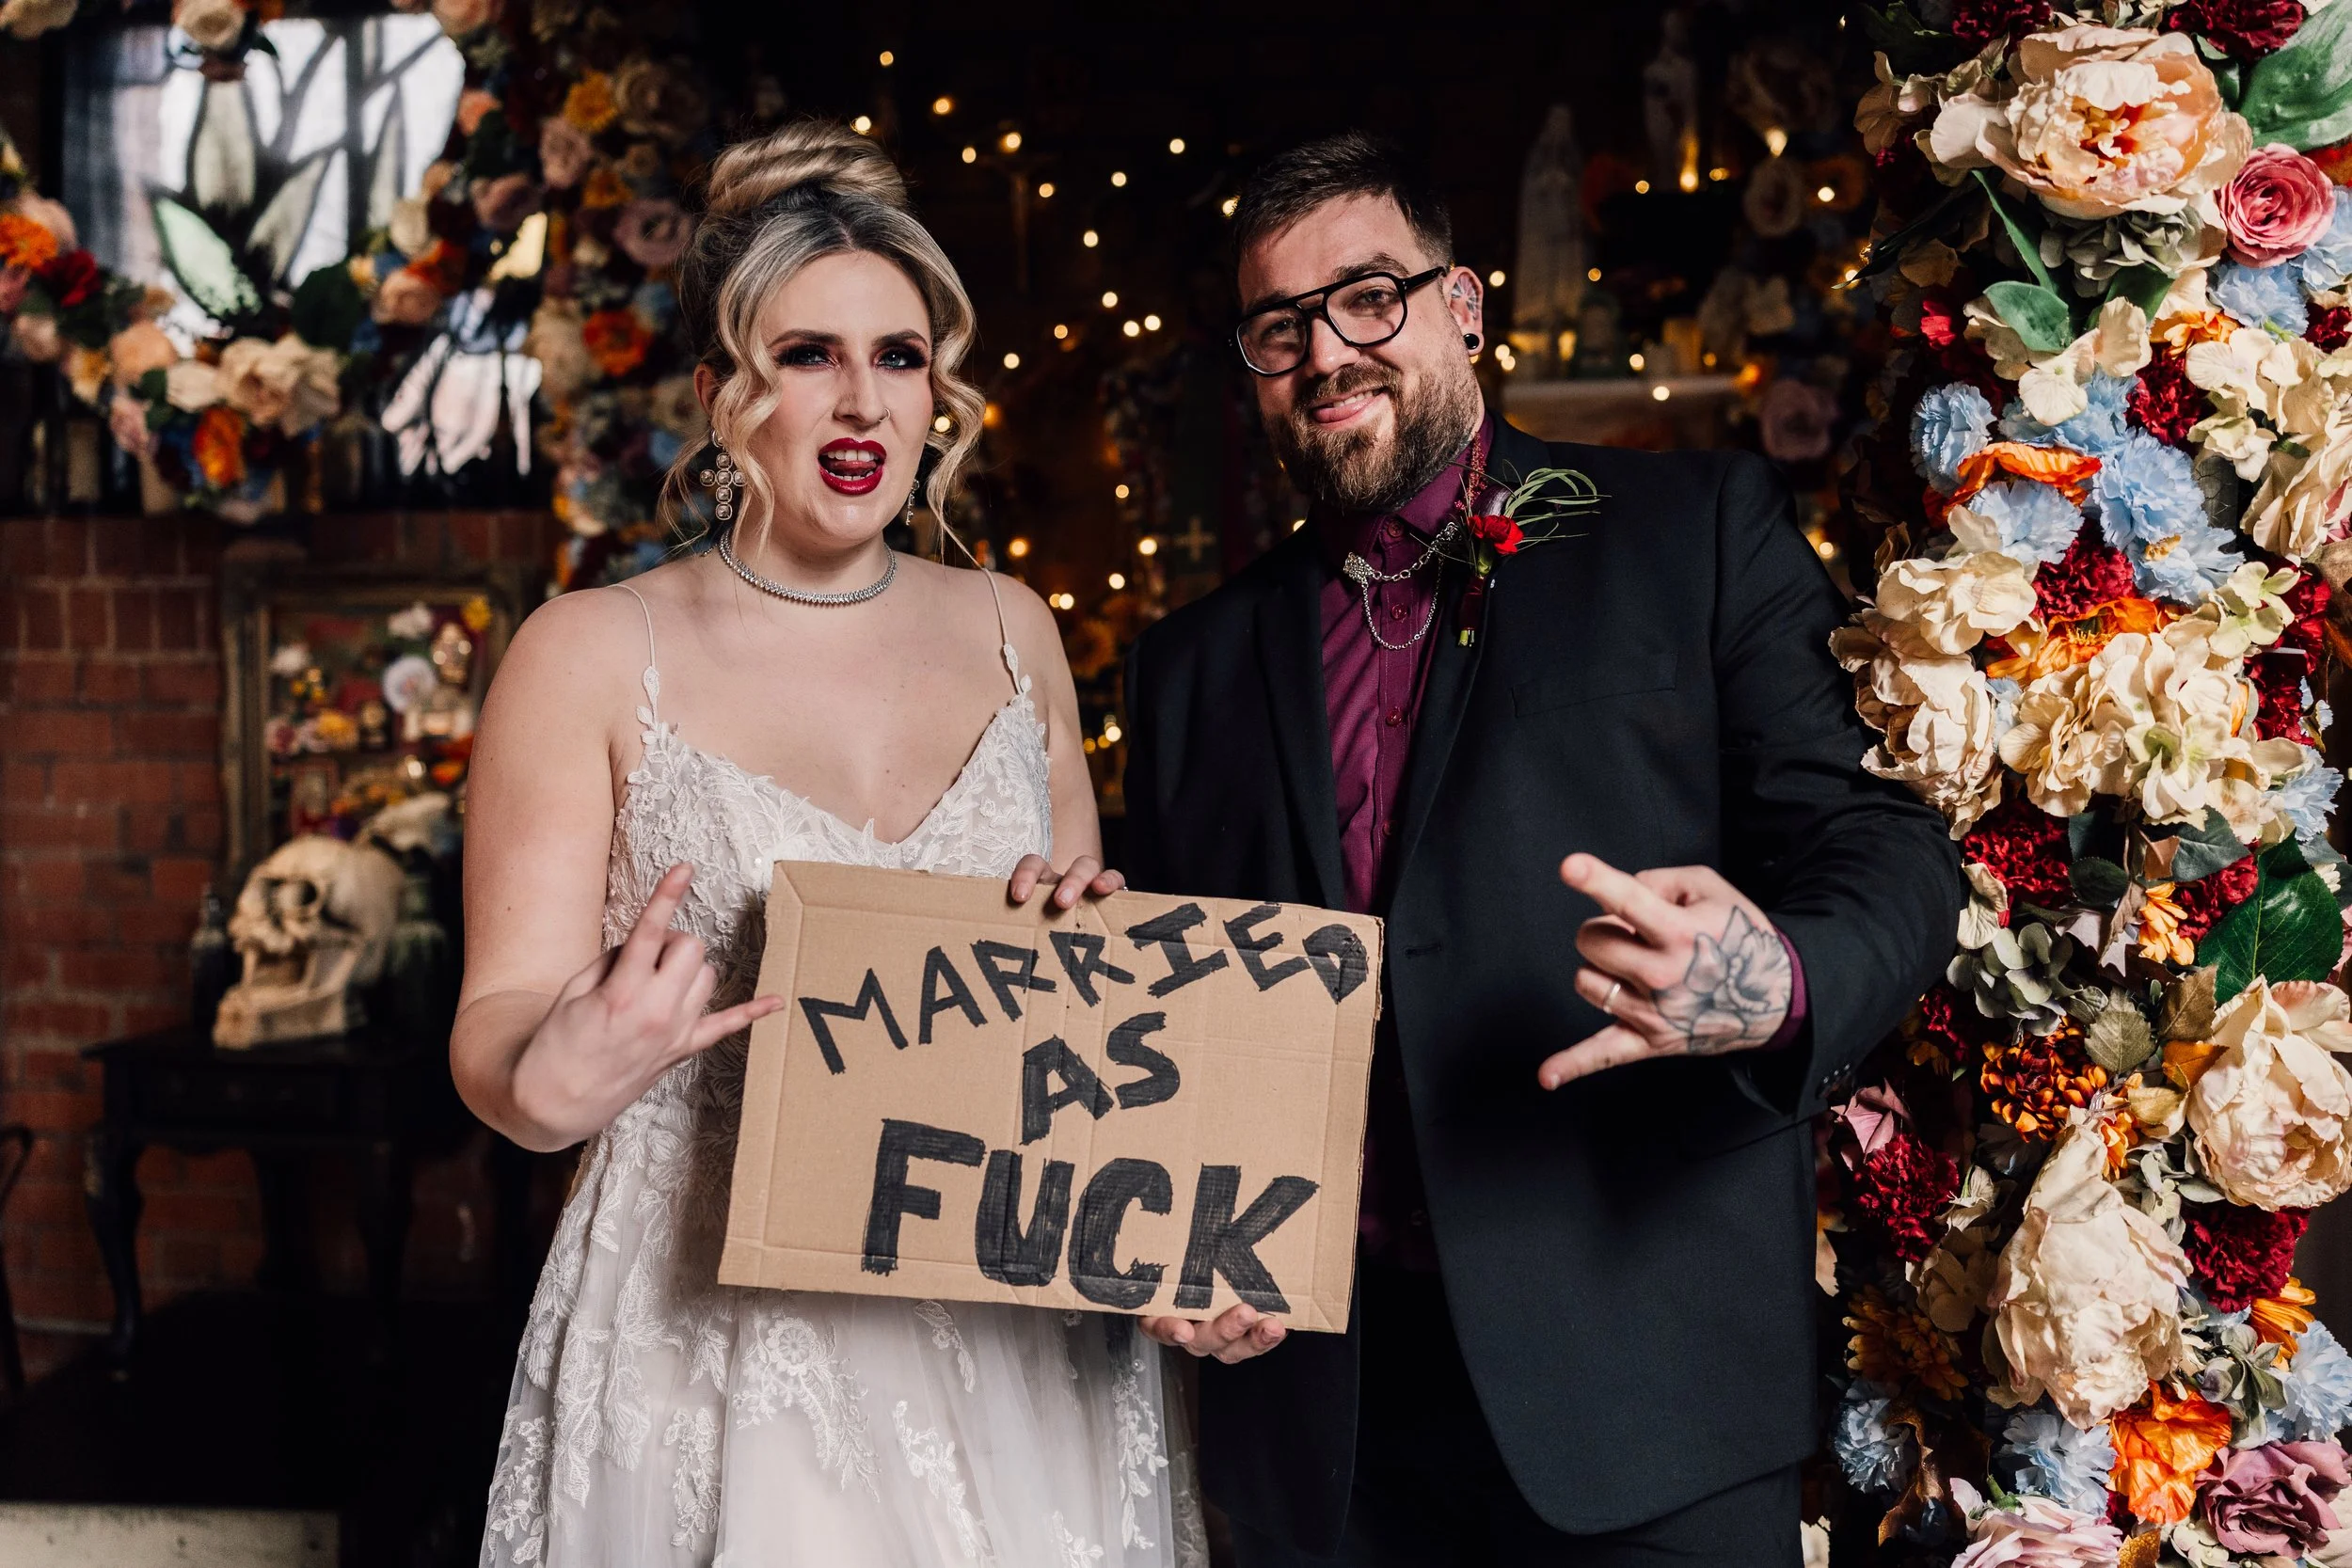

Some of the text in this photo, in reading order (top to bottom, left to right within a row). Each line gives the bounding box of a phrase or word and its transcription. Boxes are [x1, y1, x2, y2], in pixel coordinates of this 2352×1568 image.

[798, 903, 1369, 1075] MARRIED
[1020, 1011, 1181, 1145] AS
[861, 1118, 1320, 1314] FUCK
